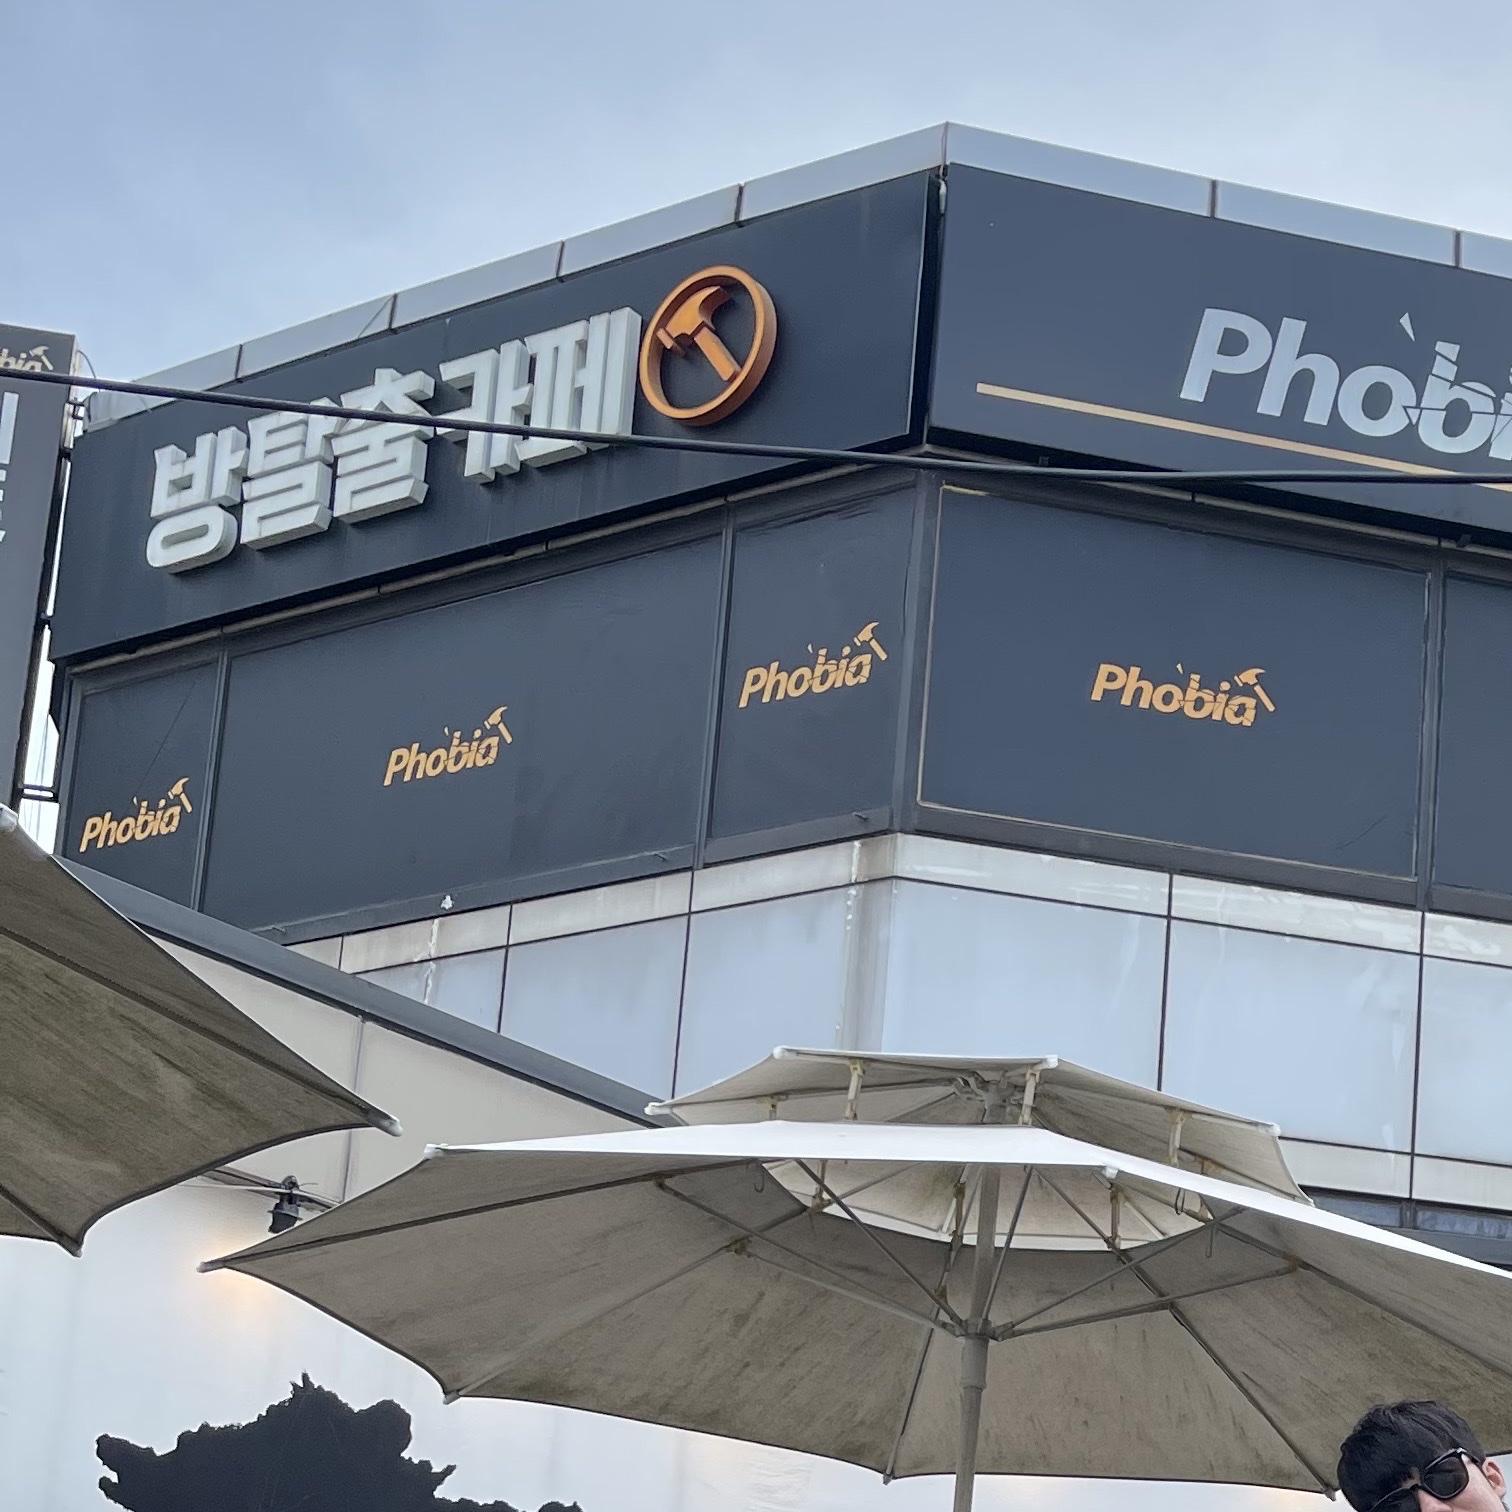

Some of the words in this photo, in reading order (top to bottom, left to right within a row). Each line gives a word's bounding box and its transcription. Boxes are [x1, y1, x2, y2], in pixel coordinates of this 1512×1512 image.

[0, 348, 42, 372] bia
[435, 306, 643, 485] 카페
[738, 643, 873, 709] Phobia
[1090, 662, 1258, 727] Phobia
[383, 726, 500, 787] Phobia
[79, 795, 182, 853] Phobia
